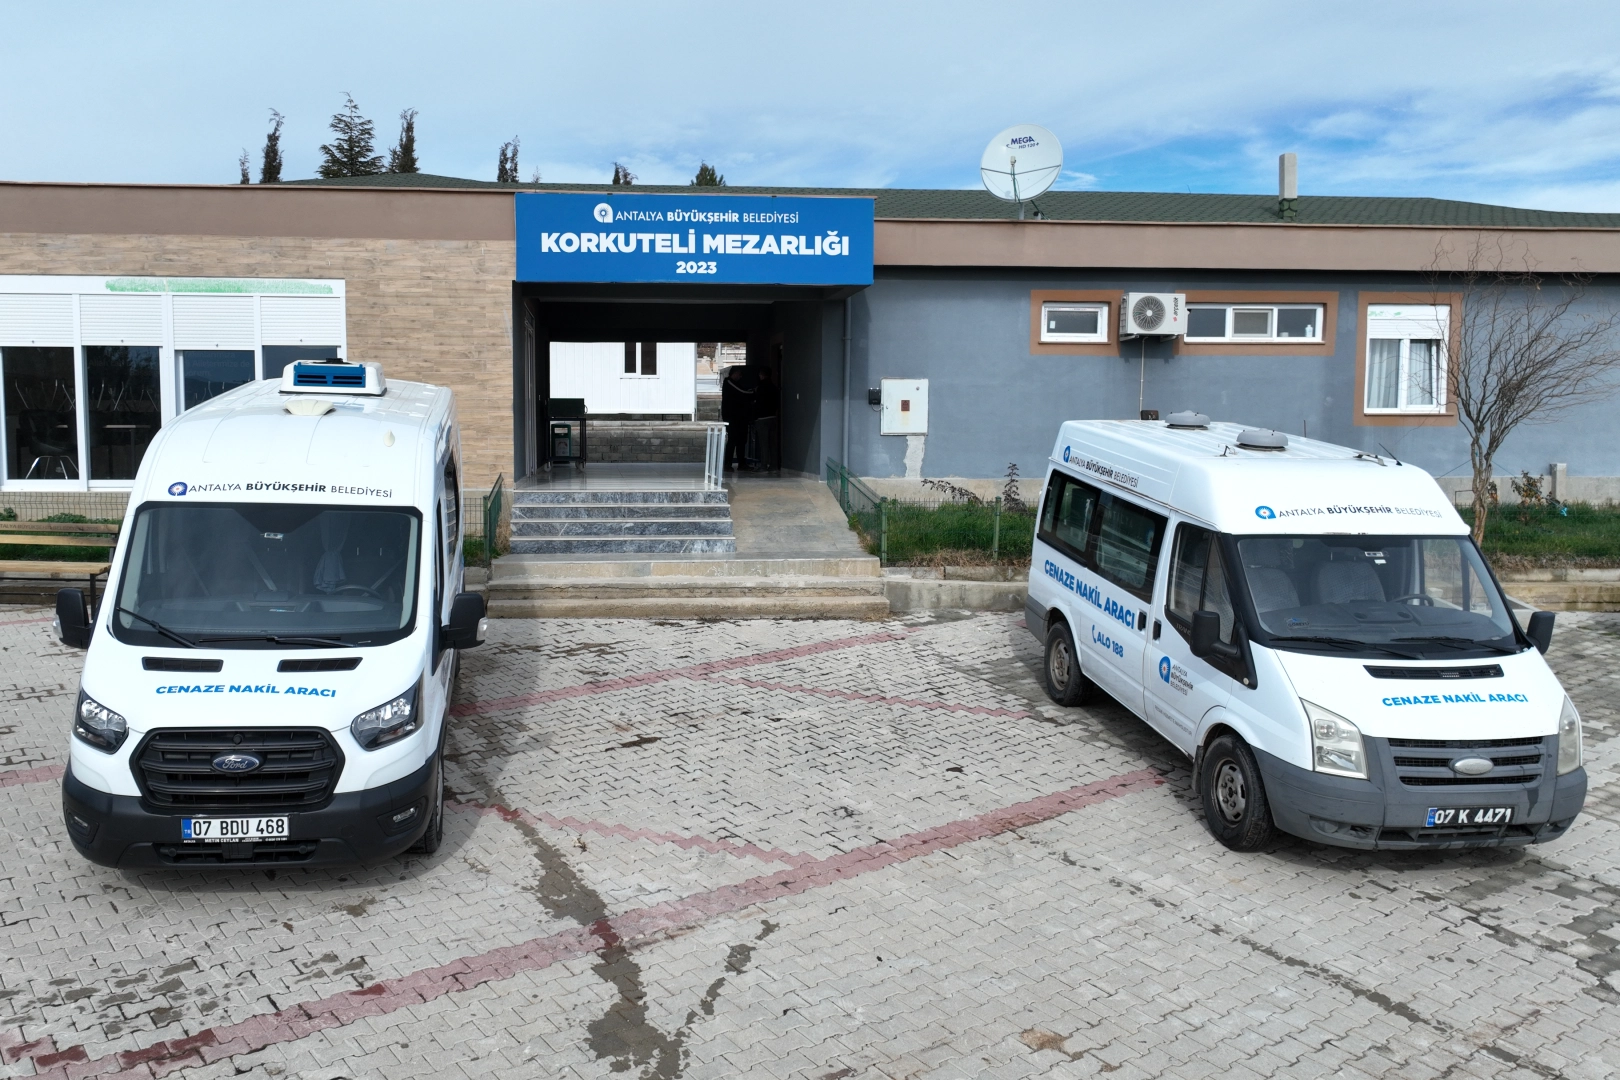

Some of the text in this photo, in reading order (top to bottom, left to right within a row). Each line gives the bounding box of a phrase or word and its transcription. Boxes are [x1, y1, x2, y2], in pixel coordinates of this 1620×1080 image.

[1010, 136, 1035, 145] MEGA
[615, 209, 799, 225] ANTALYA BÜYÜKŞEHİR BELEDİYESİ
[541, 228, 849, 256] KORKUTELİ MEZARLIĞI
[676, 261, 717, 275] 2023
[1069, 455, 1140, 488] ANTALYA BÜYÜKŞEHİR BELEDİYESİ
[188, 481, 393, 498] ANTALYA BÜYÜKŞEHİR BELEDİYESİ
[1278, 504, 1443, 519] ANTALYA BÜYÜKŞEHİR BELEDİYESİ
[1044, 559, 1135, 629] CENAZE NAKİL ARACI
[1097, 631, 1124, 658] ALO 188
[156, 683, 337, 698] CENAZE NAKİL ARACI
[1382, 691, 1529, 707] CENAZE NAKİL ARACI
[222, 755, 248, 769] Ford
[1434, 809, 1455, 824] 07
[1458, 809, 1470, 824] K
[1474, 808, 1512, 823] 4471
[193, 820, 212, 836] 07
[220, 819, 250, 836] BDU
[256, 818, 285, 835] 468
